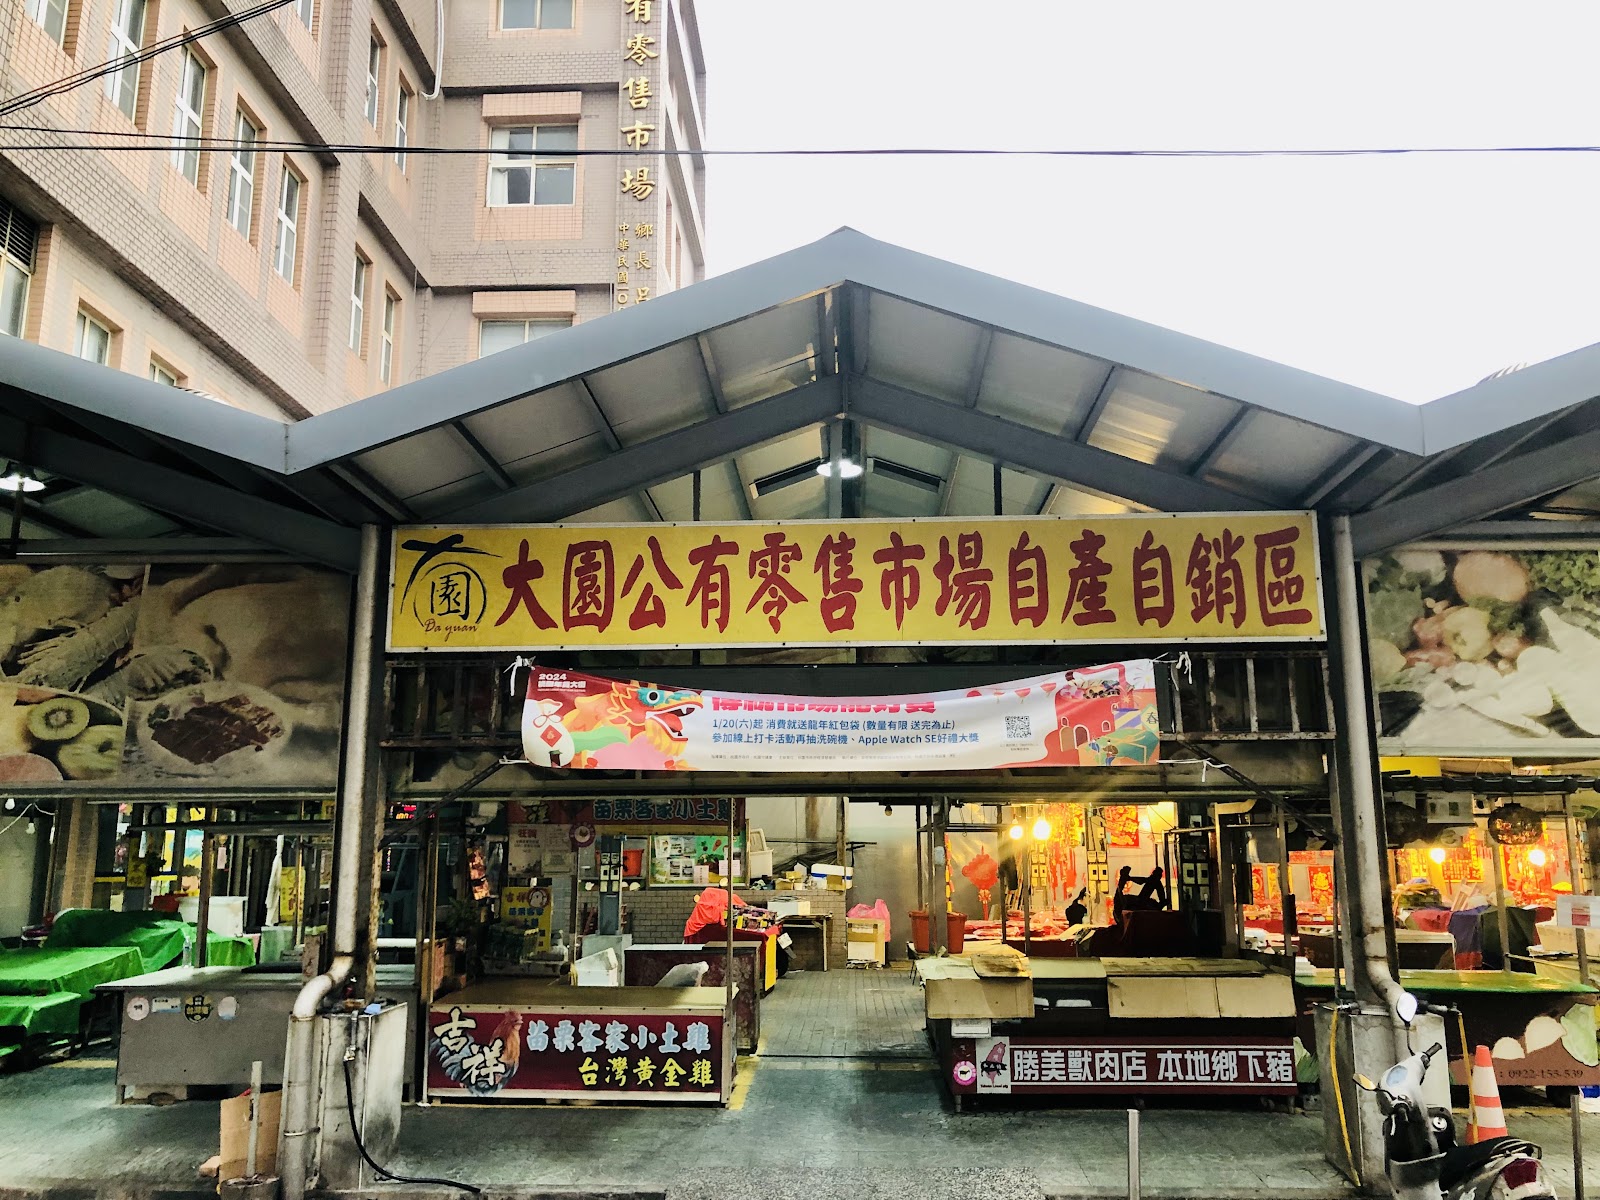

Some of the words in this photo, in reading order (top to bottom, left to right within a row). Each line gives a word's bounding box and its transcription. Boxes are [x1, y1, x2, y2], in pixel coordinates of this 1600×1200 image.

[494, 526, 1313, 634] 大園公有零售市場自產自銷區
[538, 673, 567, 681] 2024
[712, 719, 763, 729] 1/20(六)起
[890, 734, 922, 744] Watch
[433, 1007, 506, 1087] 吉祥
[526, 1019, 711, 1054] 苗栗客家小土雞
[1013, 1050, 1147, 1082] 勝美獸肉店
[1156, 1050, 1293, 1082] 本地鄉下豬
